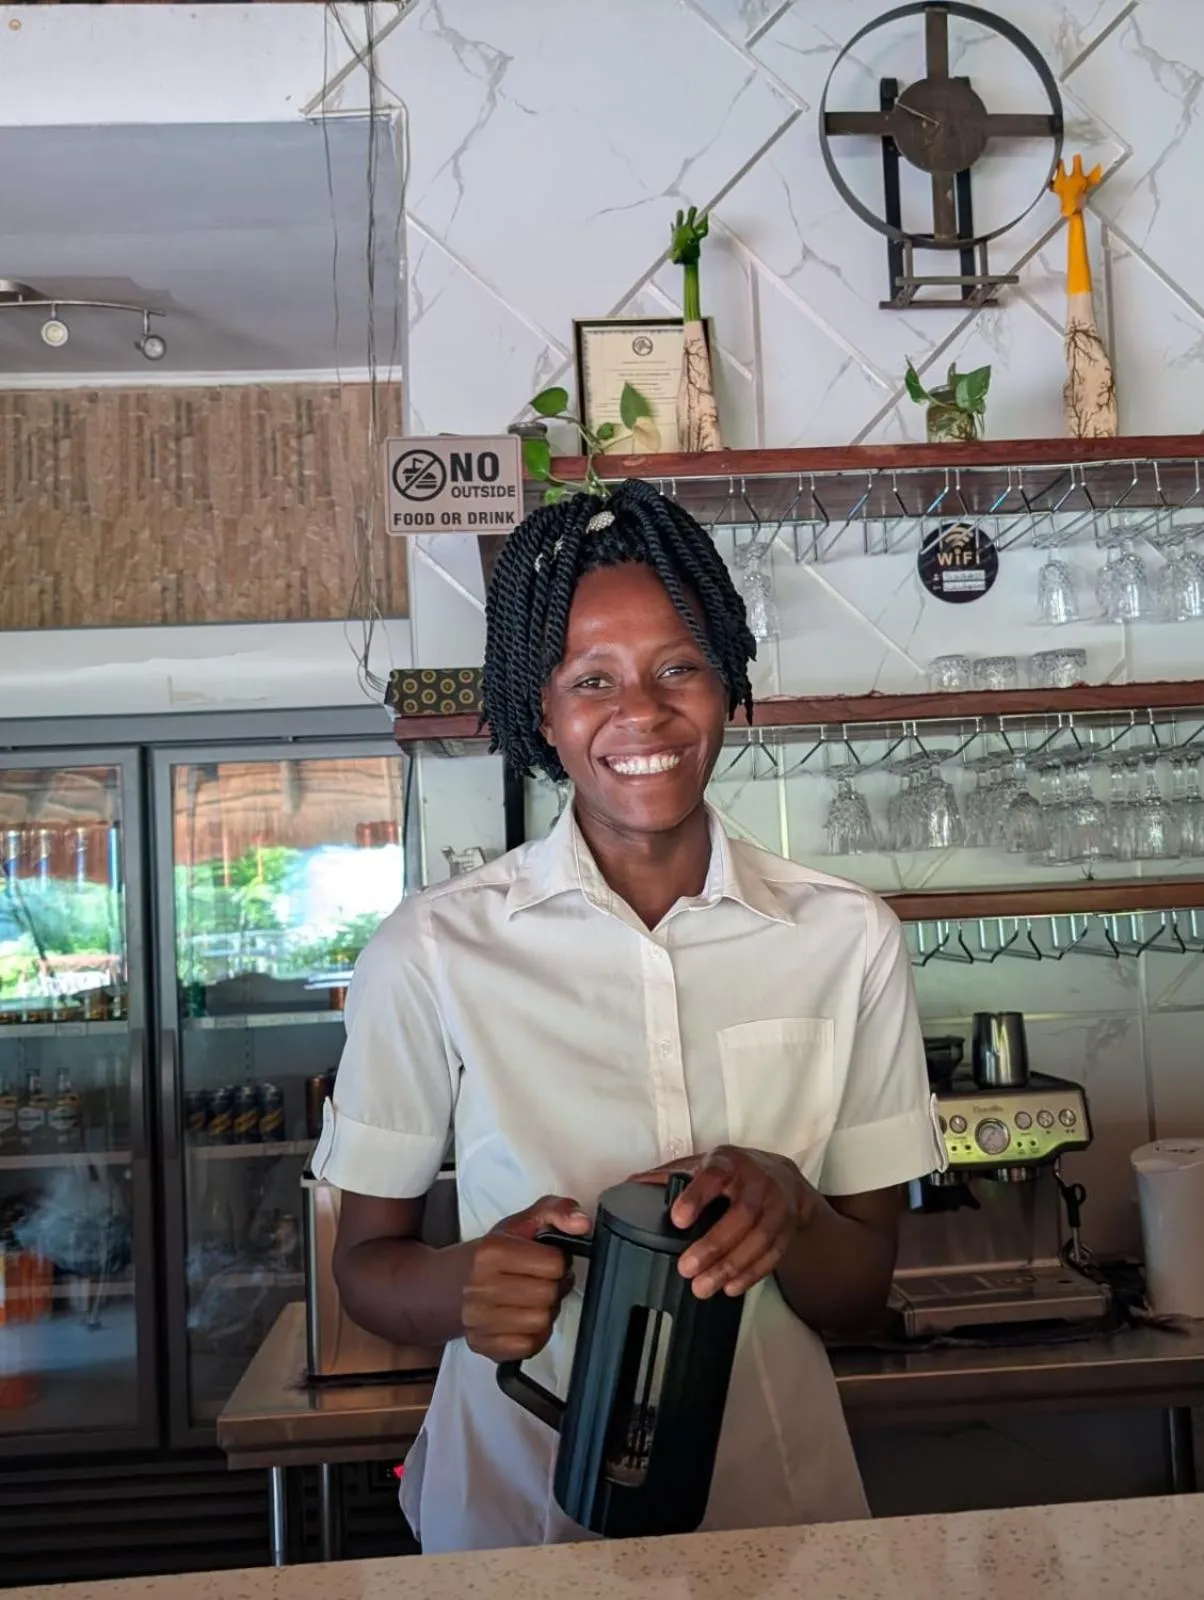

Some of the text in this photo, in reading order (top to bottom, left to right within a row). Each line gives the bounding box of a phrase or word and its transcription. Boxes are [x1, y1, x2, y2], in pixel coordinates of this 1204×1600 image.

[450, 451, 499, 482] NO
[451, 486, 516, 498] OUTSIDE
[393, 511, 515, 526] FOOD OR DRINK
